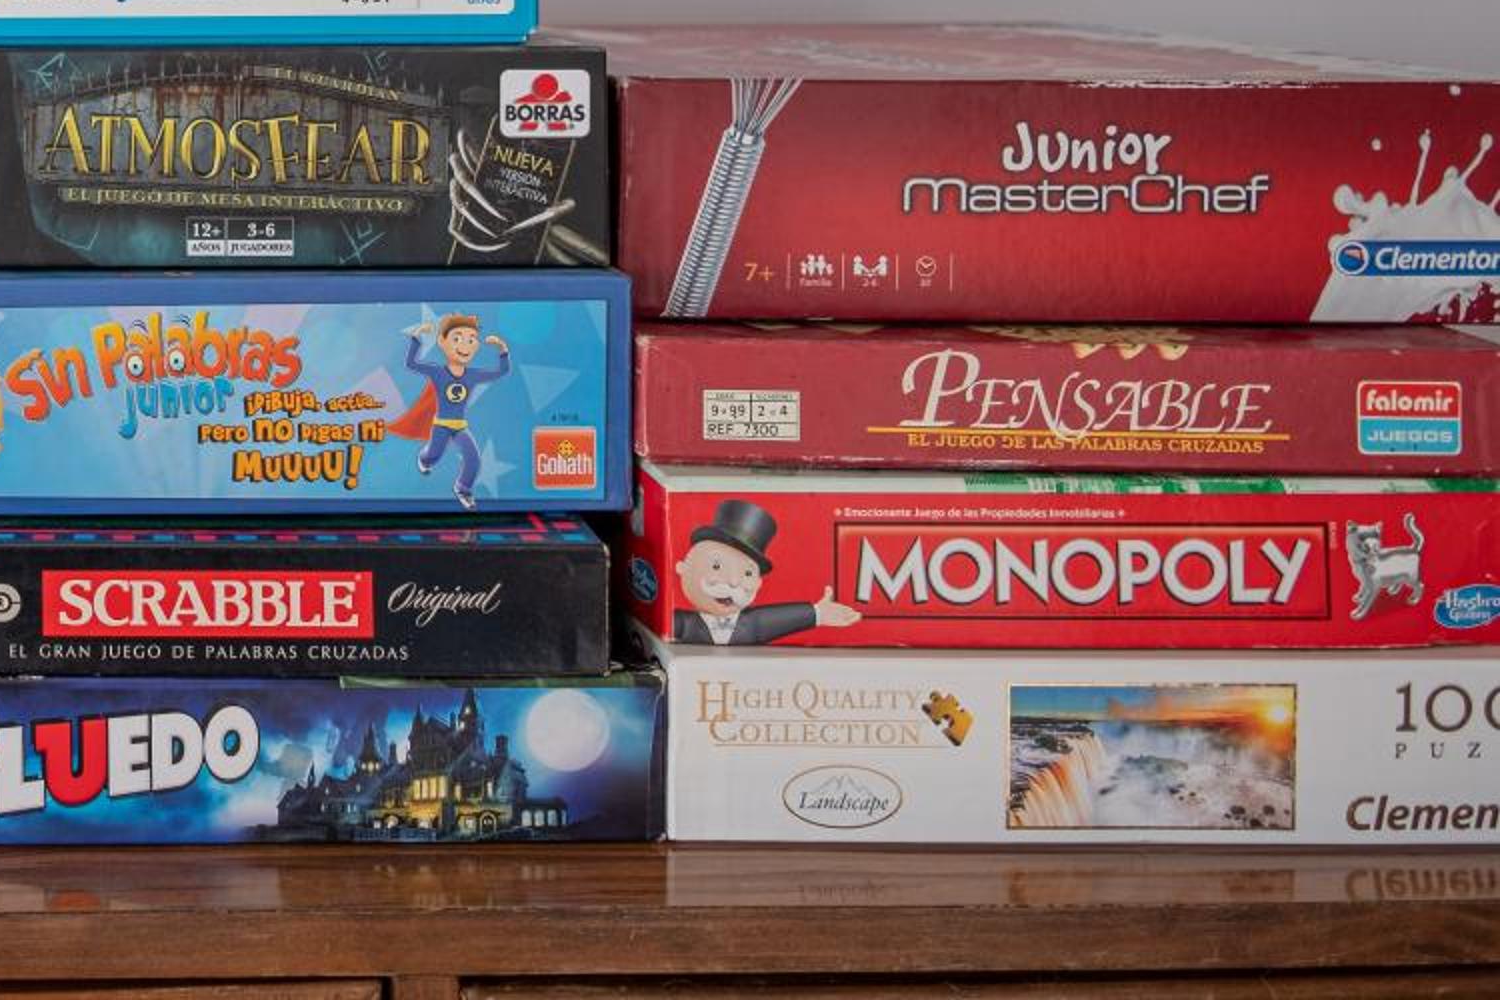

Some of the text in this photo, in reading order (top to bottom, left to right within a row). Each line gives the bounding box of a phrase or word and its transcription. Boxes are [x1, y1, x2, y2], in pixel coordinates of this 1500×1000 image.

[505, 103, 585, 122] BORRAS
[38, 104, 435, 188] ATMOSFEAR
[1002, 121, 1172, 175] Junior
[493, 146, 553, 177] NUEVA
[68, 187, 405, 212] EL JUEGO DE MESA INTERACTIVO
[192, 221, 222, 238] 12+
[246, 221, 276, 238] 3-6
[231, 242, 293, 254] JUGADORES
[745, 262, 774, 281] 7+
[4, 311, 302, 421] Sin Palabras
[898, 347, 1273, 441] PENSABLE
[1366, 389, 1453, 412] falomir
[743, 424, 779, 437] 7300
[1367, 430, 1453, 443] JUEGOS
[907, 433, 930, 447] EL
[935, 434, 995, 449] JUEGO
[1032, 436, 1065, 450] LAS
[1070, 438, 1162, 452] PALABRAS
[1167, 439, 1265, 454] CRUZADAS
[537, 453, 593, 475] Goliath
[843, 507, 911, 517] Emocionante
[913, 507, 945, 519] Juego
[947, 507, 961, 517] de
[963, 507, 978, 517] las
[980, 507, 1047, 520] Propiedades
[856, 536, 1312, 604] MONOPOLY
[58, 579, 359, 627] SCRABBLE
[386, 581, 503, 628] Original
[9, 644, 409, 660] EL GRAN JUEGO DE PALABRAS CRUZADAS
[696, 680, 921, 722] HIGH QUALITY
[708, 713, 920, 745] COLLECTION
[798, 791, 890, 816] Landscape
[1346, 795, 1500, 831] Clemen
